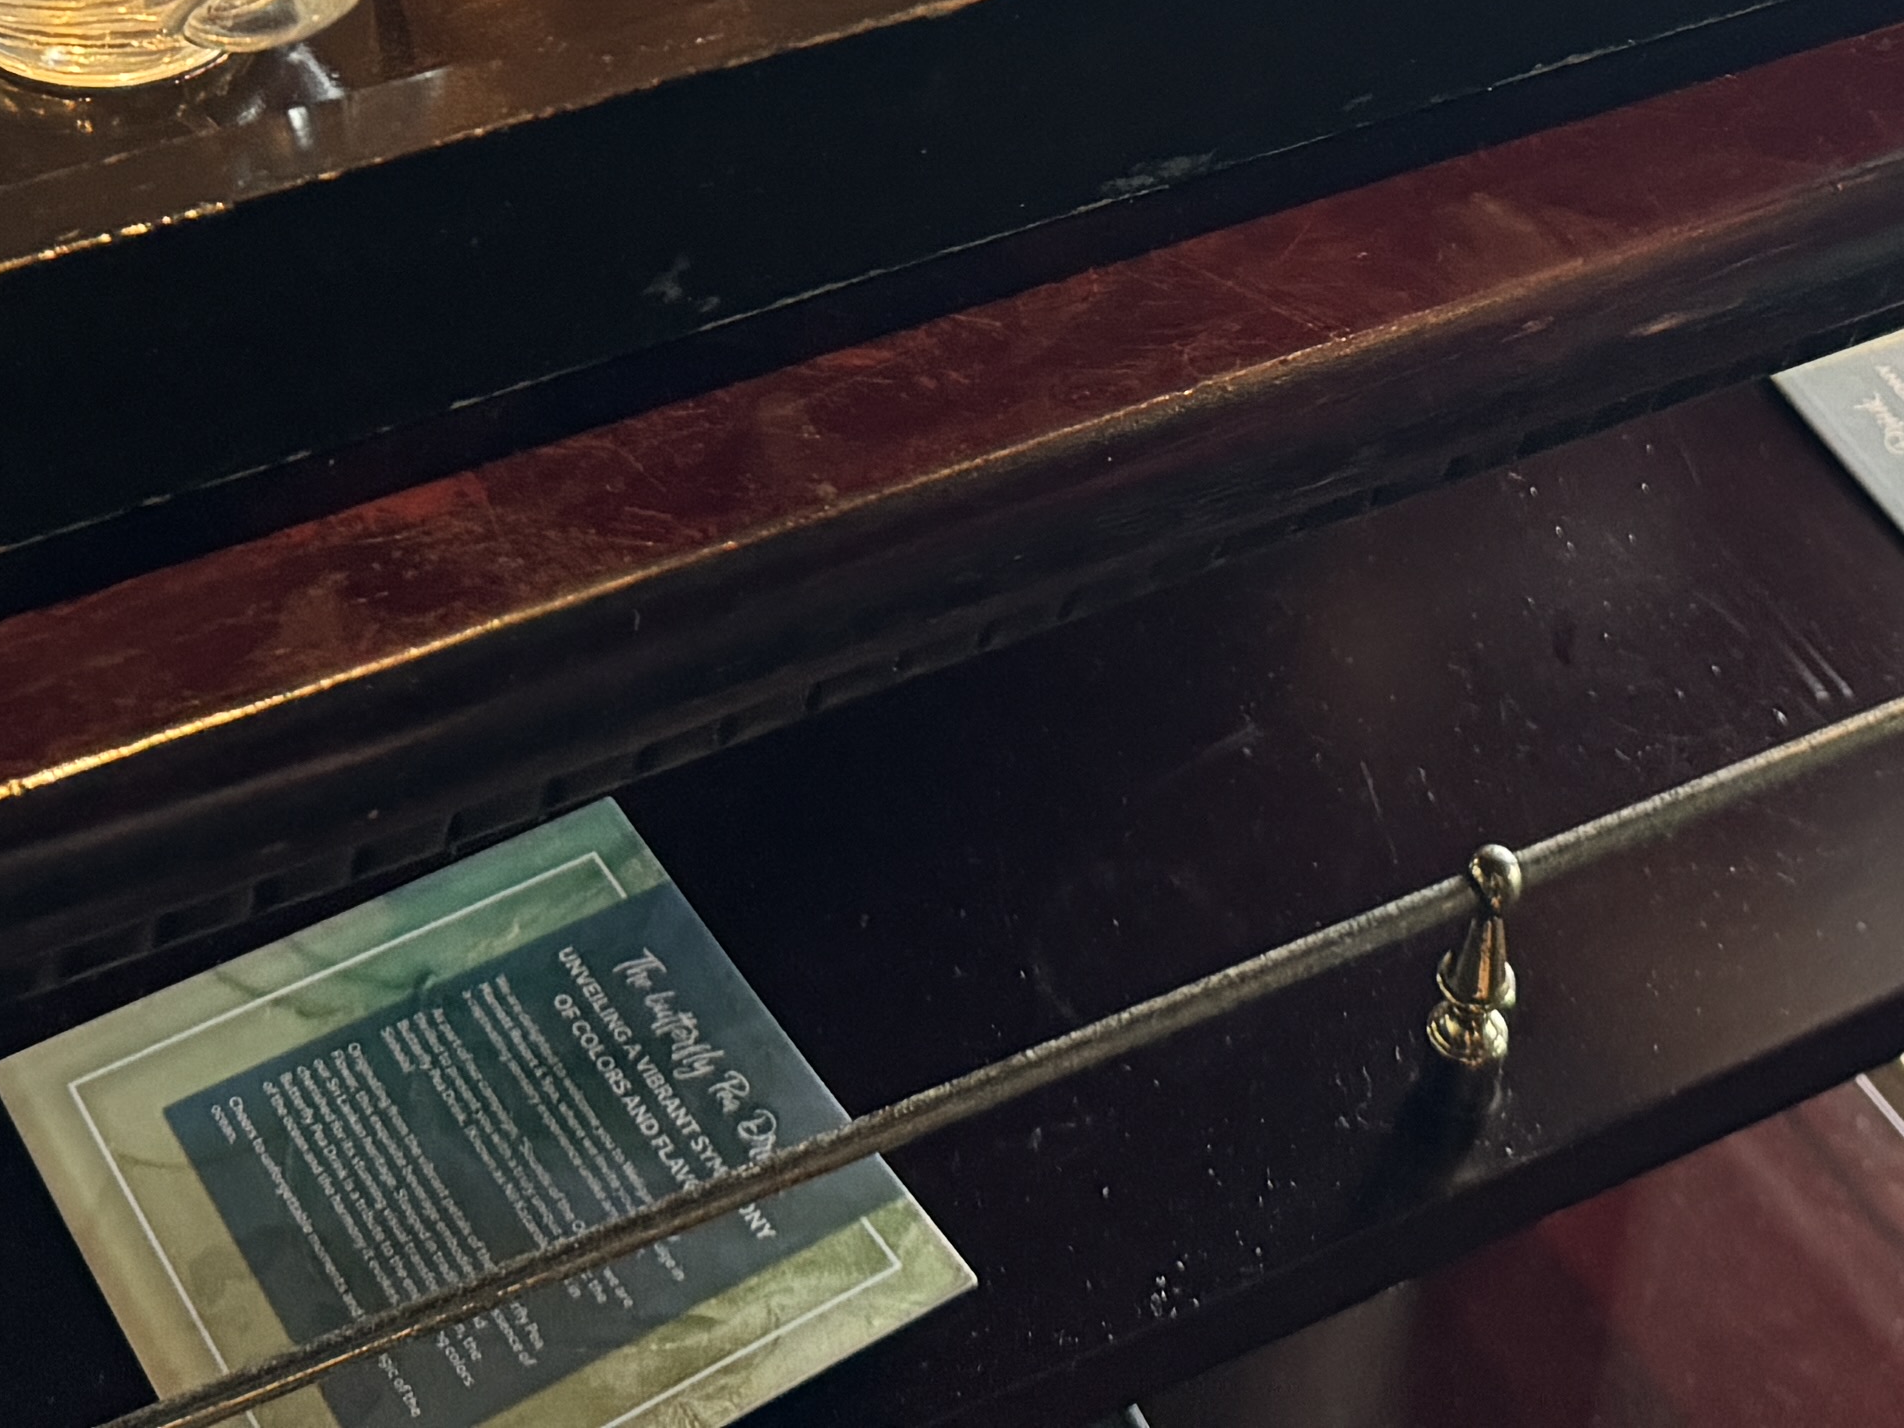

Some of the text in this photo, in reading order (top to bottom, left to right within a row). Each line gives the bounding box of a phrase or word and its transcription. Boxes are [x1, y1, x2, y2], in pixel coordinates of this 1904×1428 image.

[553, 993, 580, 1018] OF
[572, 1020, 630, 1094] COLORS
[621, 1095, 658, 1135] AND
[558, 946, 631, 1041] UNVEILING
[622, 1043, 642, 1060] A
[637, 1056, 699, 1134] VIBRANT
[612, 947, 666, 987] The
[707, 1070, 749, 1114] Pea
[347, 1042, 390, 1108] Originating
[387, 1104, 408, 1136] from
[404, 1133, 421, 1156] the
[418, 1155, 449, 1197] vibrant
[441, 1197, 471, 1235] petals
[466, 1234, 485, 1248] of
[279, 1071, 474, 1387] Butterfly Pea Drink is a tribute to the colors
[462, 1336, 482, 1361] the
[490, 1308, 523, 1352] ssence
